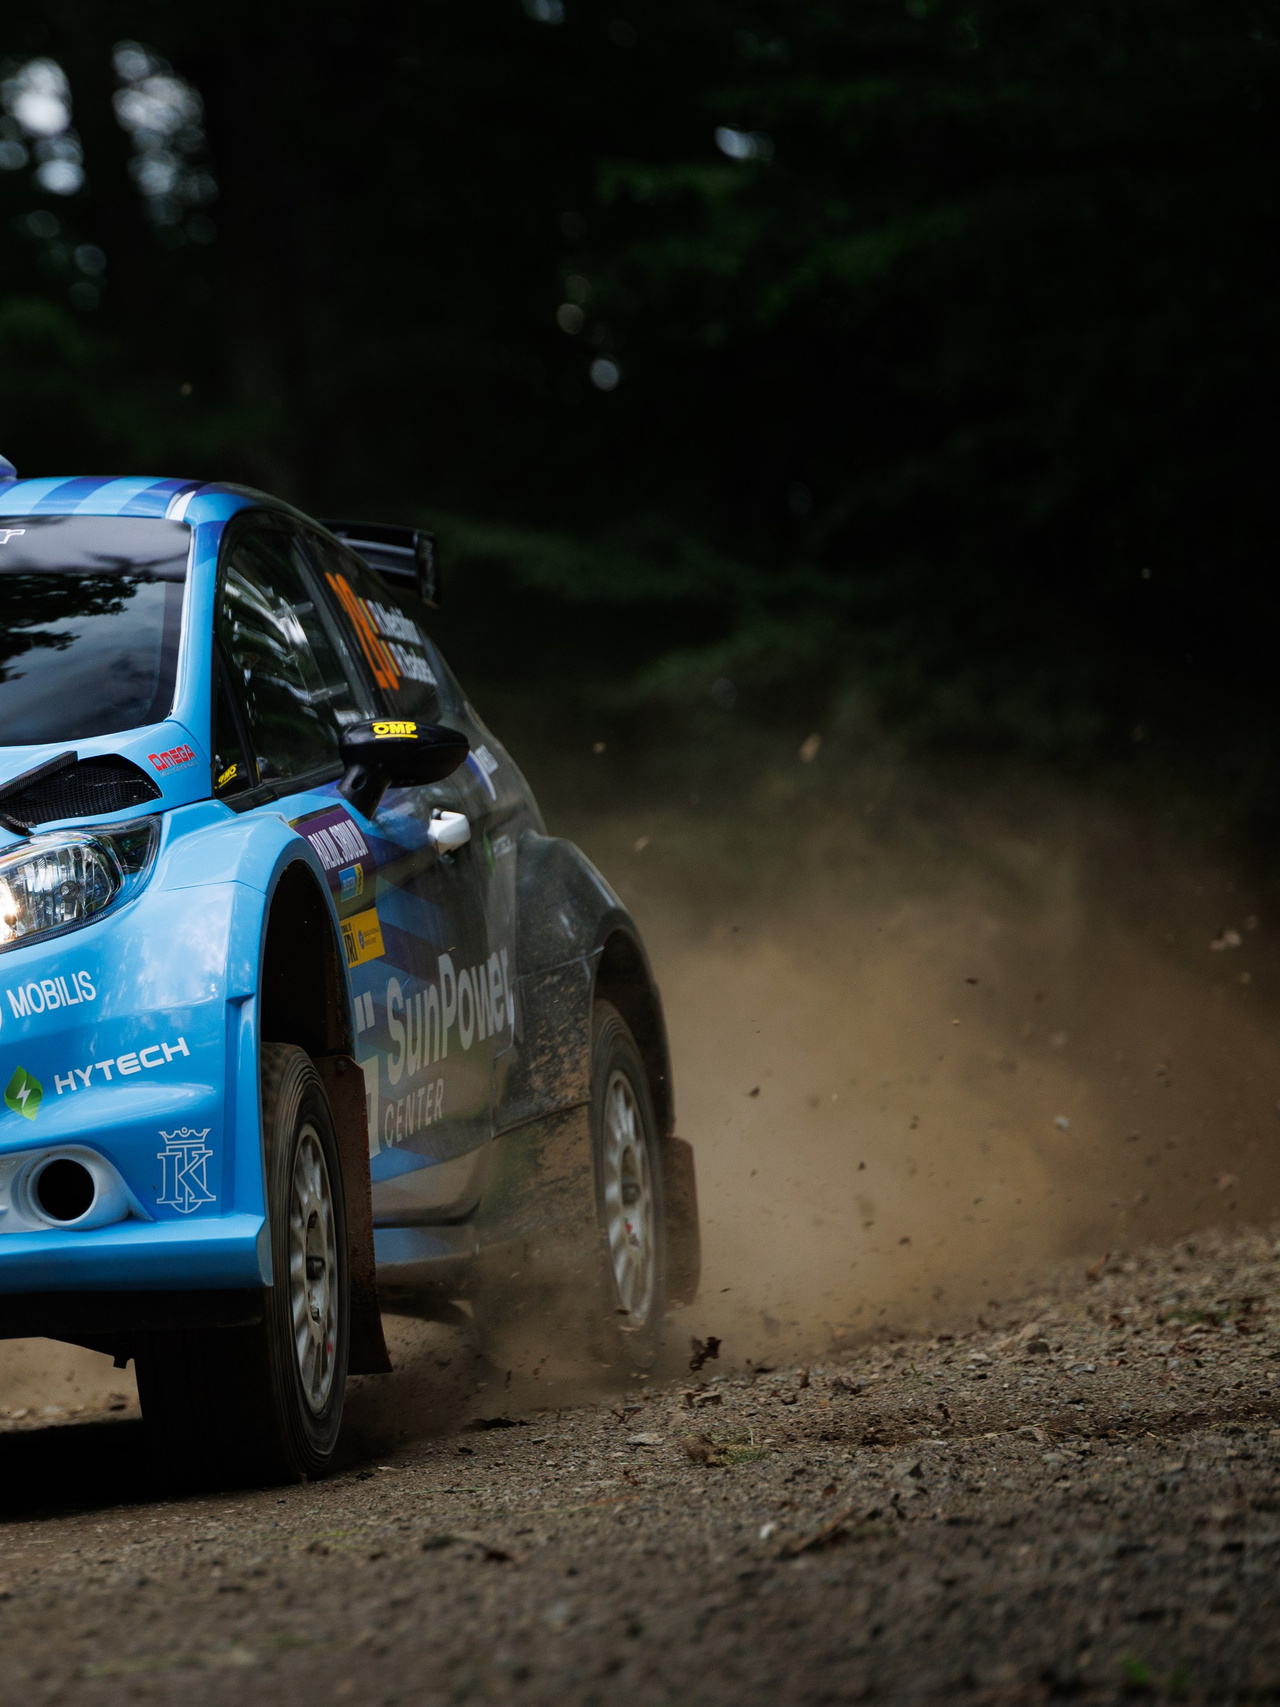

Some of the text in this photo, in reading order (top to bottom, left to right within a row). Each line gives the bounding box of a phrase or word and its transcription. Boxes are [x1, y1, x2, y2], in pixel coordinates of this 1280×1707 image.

[373, 723, 417, 735] OMP
[148, 744, 197, 771] OMEGA
[307, 819, 370, 871] RALIUL SIBIULUI
[6, 970, 97, 1019] MOBILIS
[386, 947, 516, 1086] SunPower
[53, 1036, 191, 1095] HYTECH
[384, 1078, 445, 1148] CENTER
